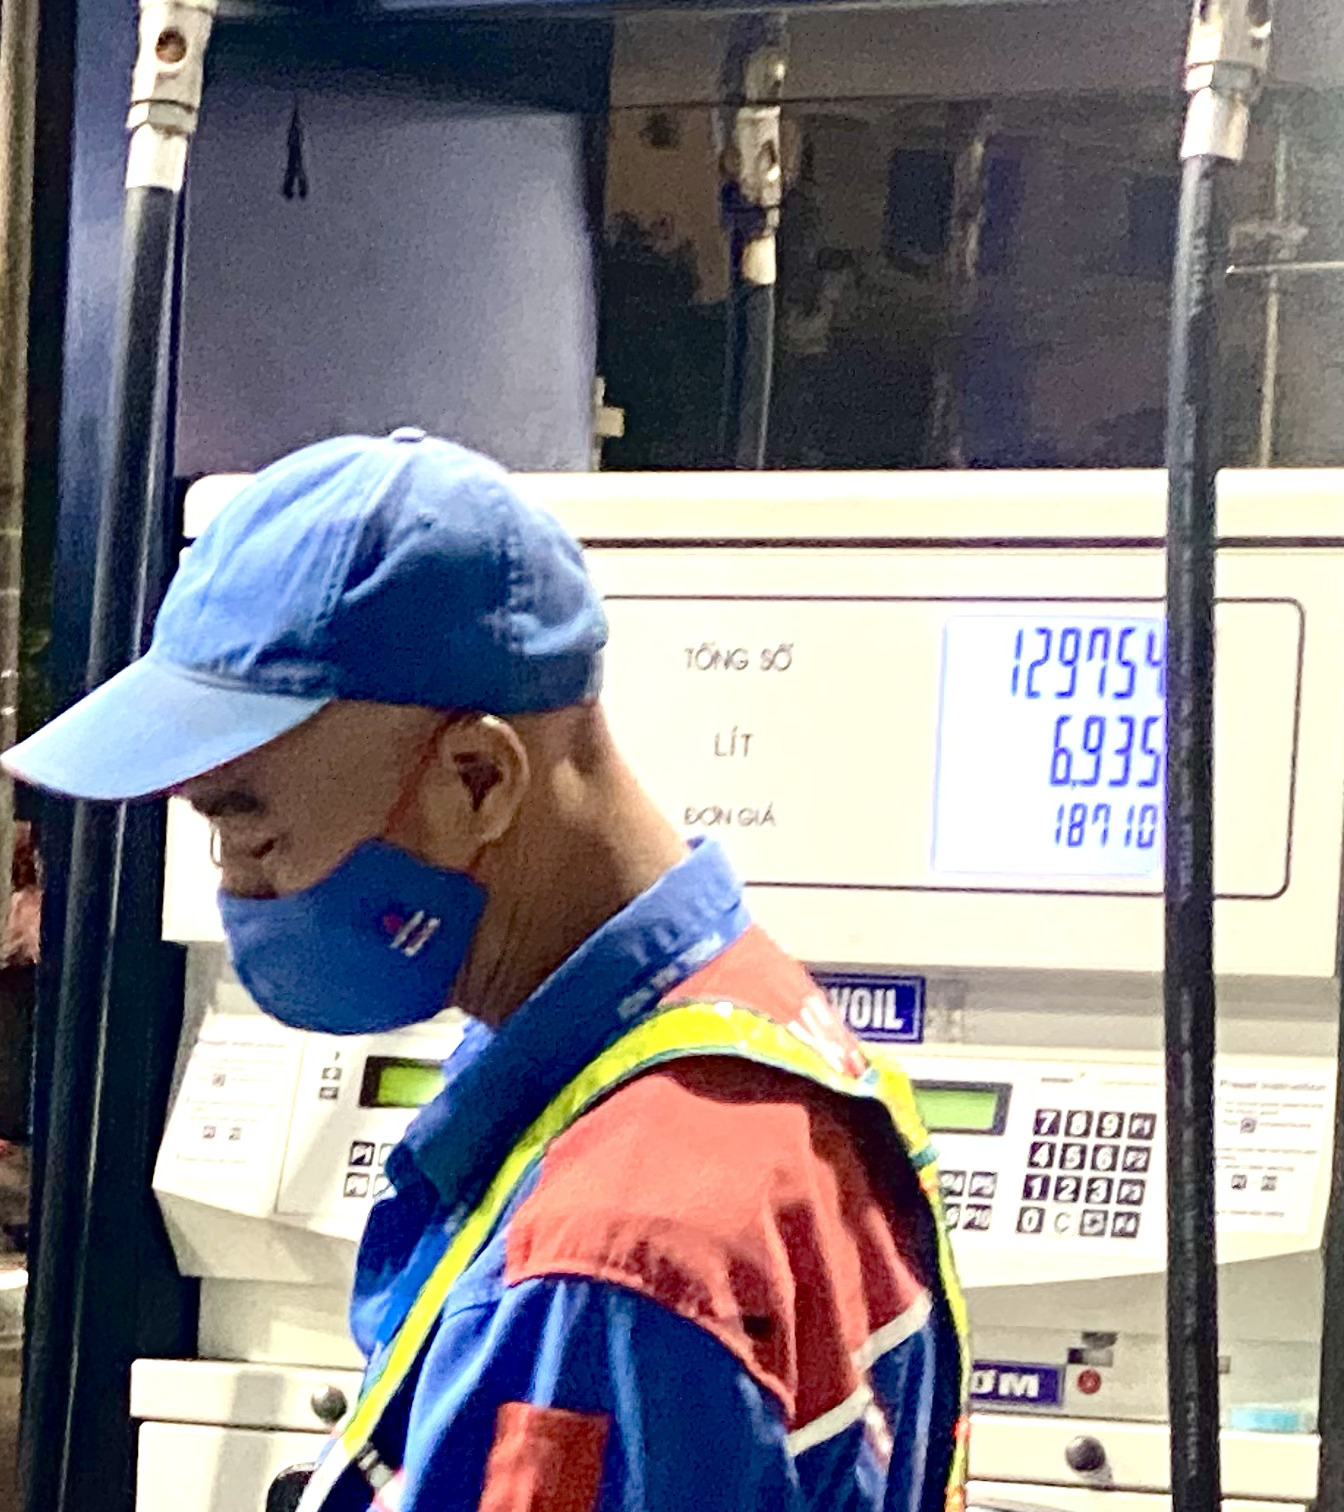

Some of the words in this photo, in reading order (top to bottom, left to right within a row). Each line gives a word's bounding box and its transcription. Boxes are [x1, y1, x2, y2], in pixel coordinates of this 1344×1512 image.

[1010, 624, 1165, 700] 129754
[713, 724, 754, 758] LÍT
[1053, 802, 1160, 851] 18710
[826, 985, 906, 1031] VOIL
[1037, 1112, 1058, 1135] 7
[1032, 1143, 1050, 1168] 4
[1029, 1177, 1044, 1200] 1
[1058, 1177, 1078, 1201] 2
[1088, 1178, 1109, 1204] 3
